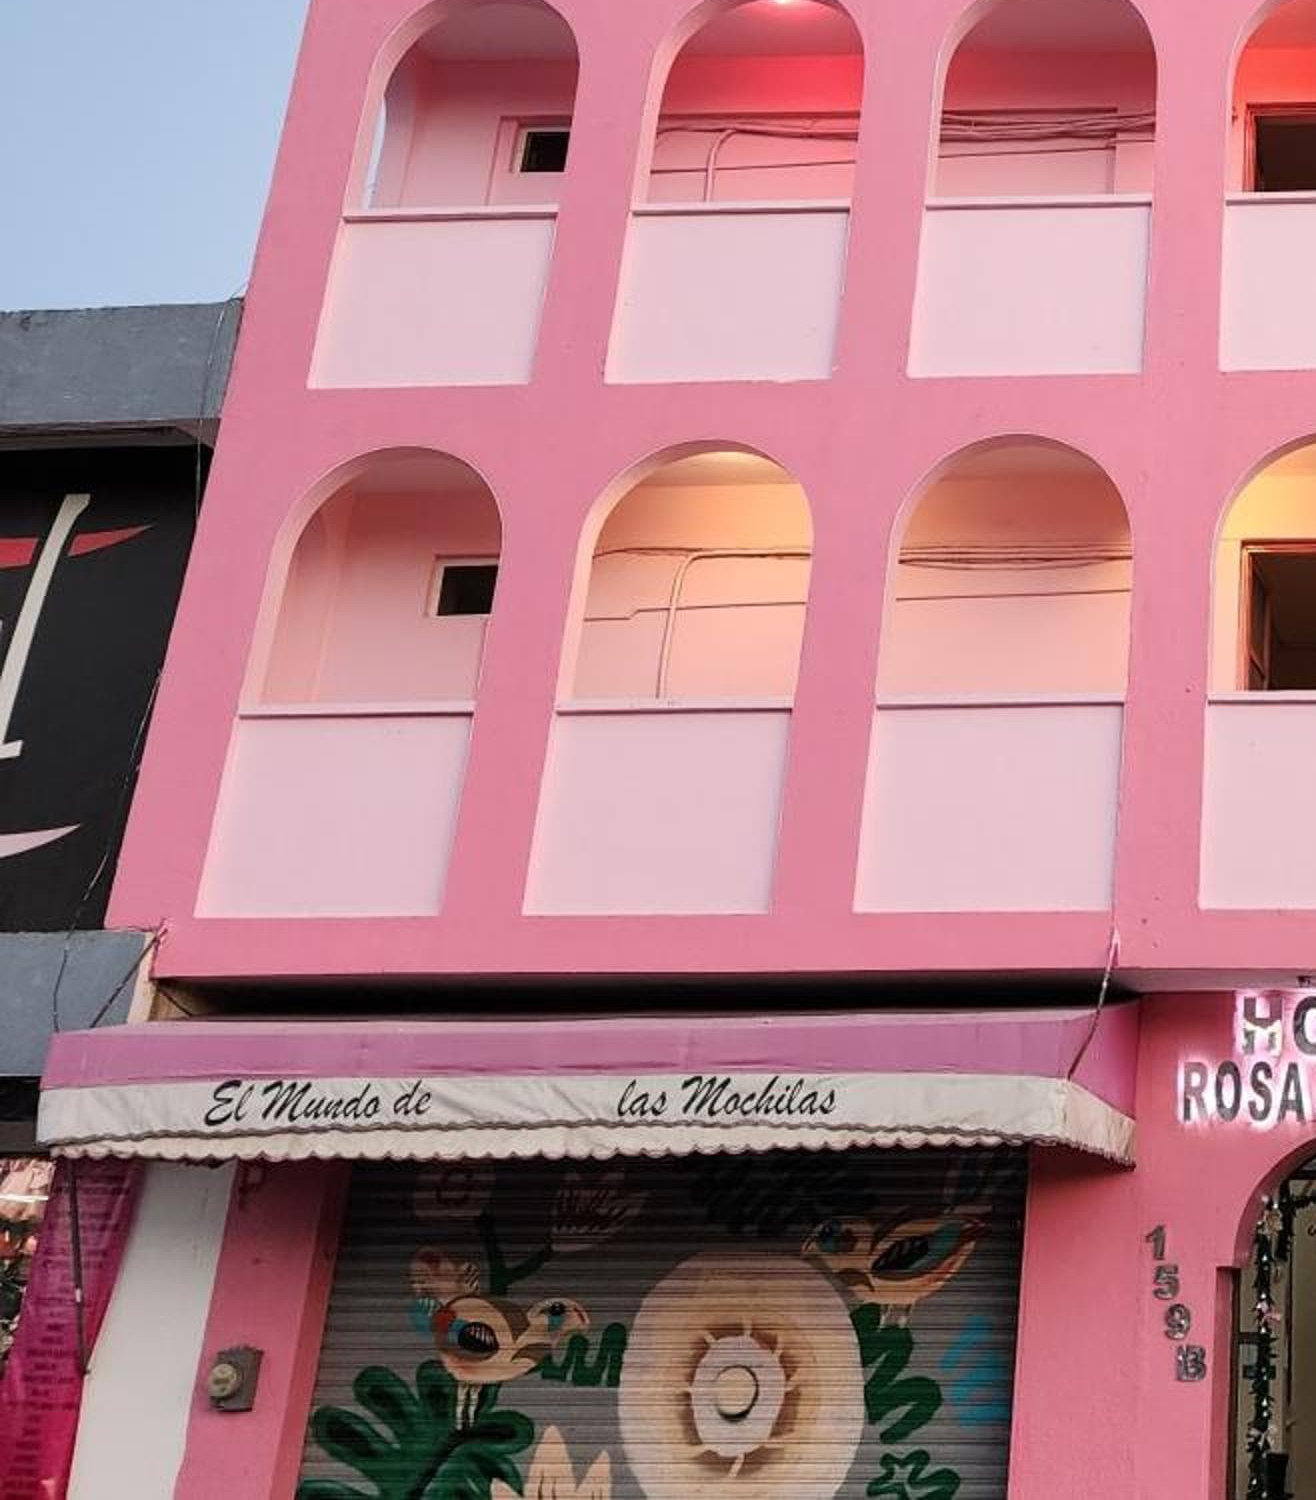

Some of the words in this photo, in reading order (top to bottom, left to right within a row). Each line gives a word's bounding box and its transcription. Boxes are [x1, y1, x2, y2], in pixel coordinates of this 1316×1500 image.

[203, 1079, 255, 1127] El
[261, 1080, 381, 1123] Mundo
[393, 1078, 433, 1116] de
[616, 1078, 668, 1117] las
[681, 1075, 837, 1117] Mochilas
[1182, 1060, 1307, 1123] ROSA
